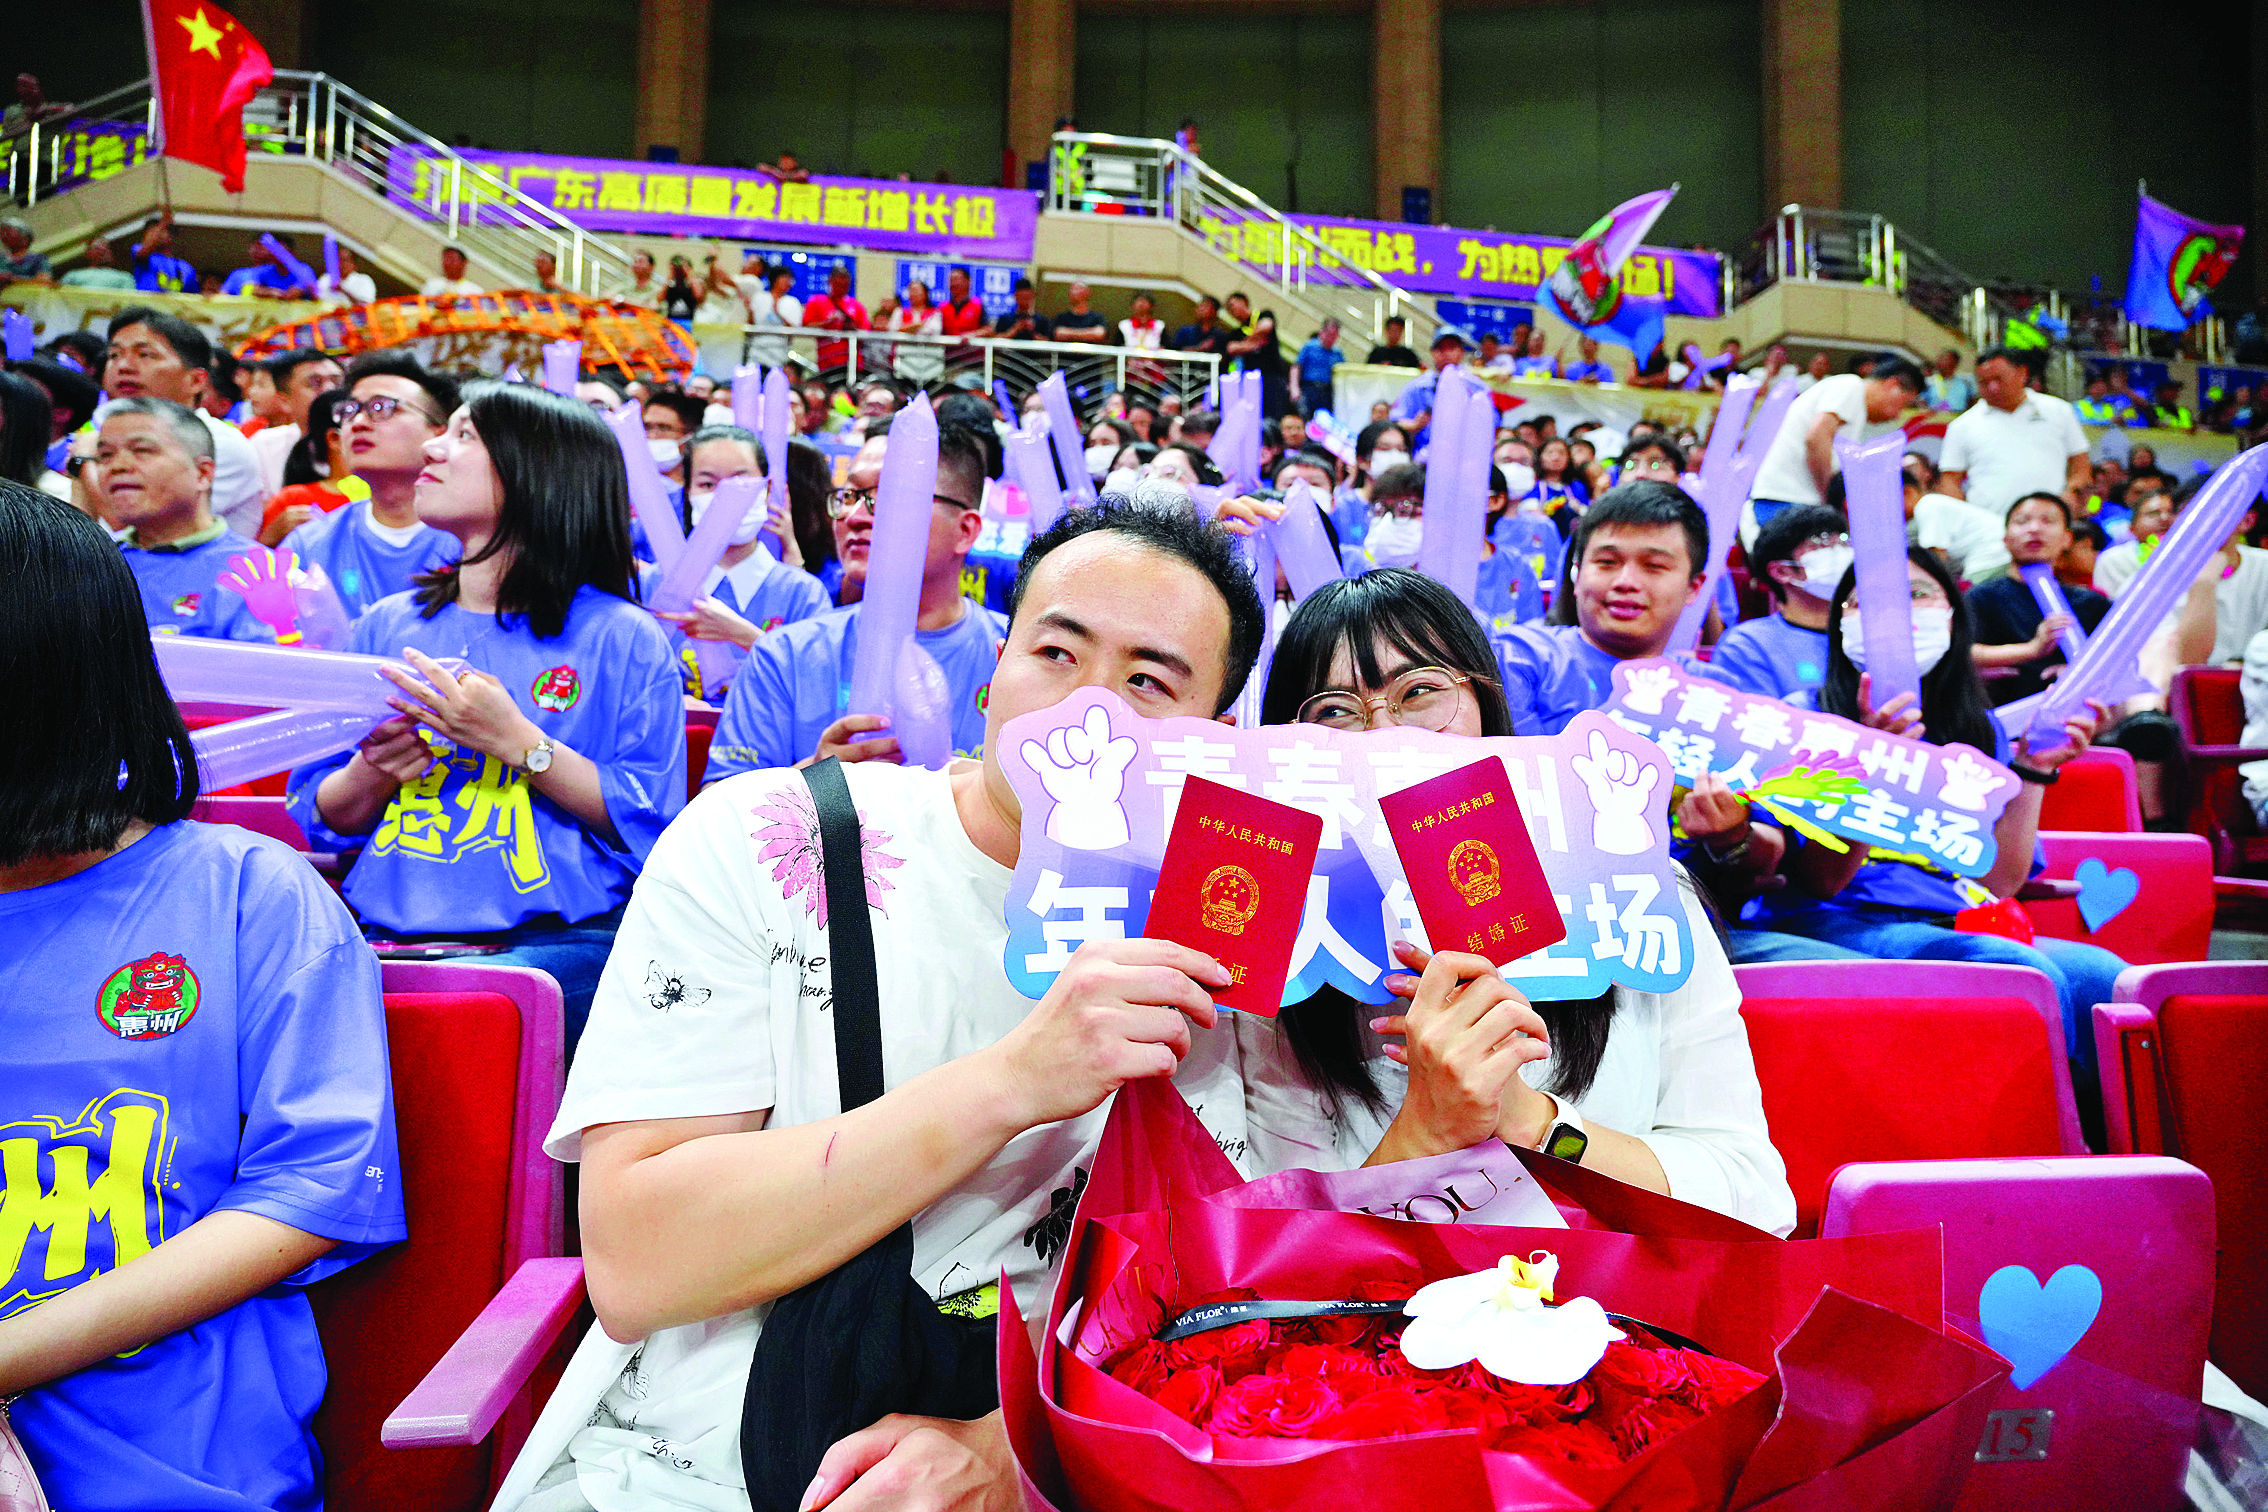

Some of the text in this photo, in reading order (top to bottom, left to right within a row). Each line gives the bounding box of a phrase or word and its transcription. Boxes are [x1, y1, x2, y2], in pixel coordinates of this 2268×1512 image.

[1411, 791, 1496, 834] 中华人民共和国
[1198, 815, 1294, 856] 中华人民共和国
[1466, 913, 1530, 954] 结婚证
[113, 1008, 185, 1038] 惠州
[1175, 1315, 1195, 1327] VIA
[1988, 1416, 2037, 1455] 15
